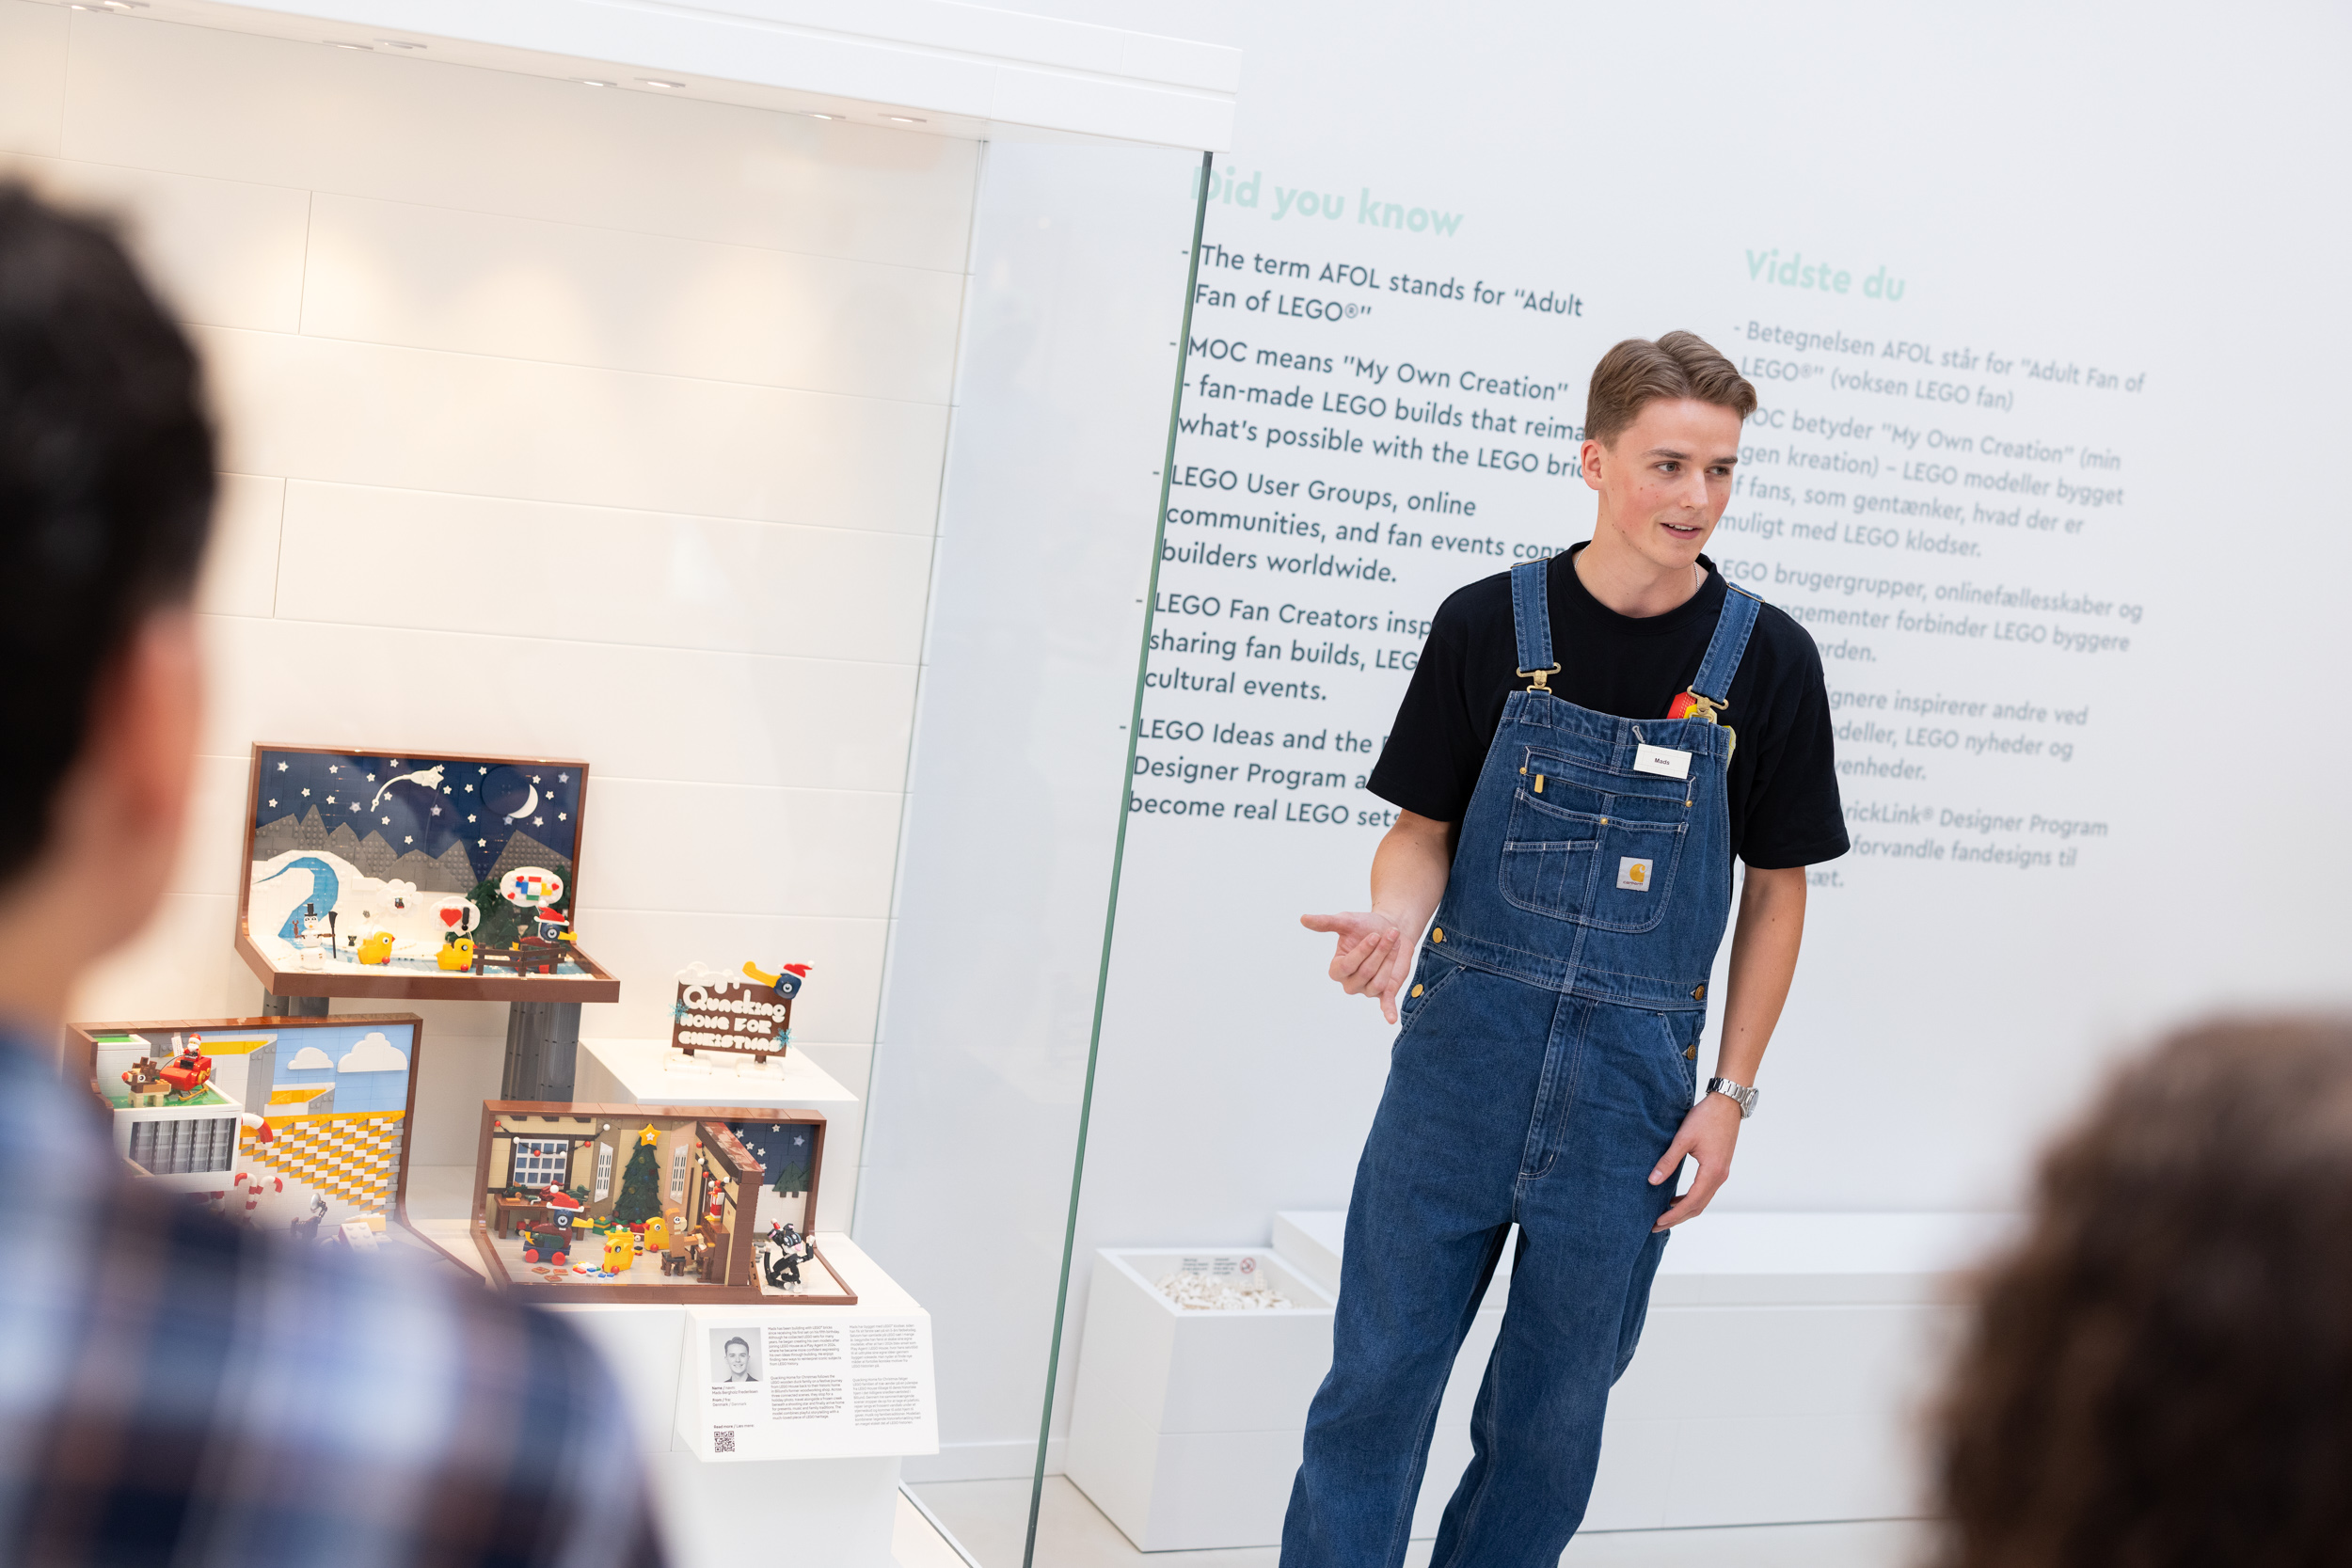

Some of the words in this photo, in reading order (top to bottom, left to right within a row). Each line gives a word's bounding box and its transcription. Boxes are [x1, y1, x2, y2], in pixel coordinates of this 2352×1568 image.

[1190, 166, 1262, 208] Did
[1270, 184, 1344, 221] you
[1358, 187, 1464, 237] know
[1195, 283, 1235, 309] Fan
[1246, 290, 1271, 312] of
[1200, 244, 1245, 270] The
[1254, 253, 1310, 279] term
[1319, 262, 1380, 289] AFOL
[1389, 275, 1464, 300] stands
[1473, 280, 1505, 306] for
[1747, 249, 1850, 293] Vidste
[1865, 267, 1904, 300] du
[1188, 337, 1248, 362] MOC
[1256, 350, 1333, 373] means
[1397, 363, 1450, 388] Own
[1747, 321, 1874, 356] Betegnelsen
[1882, 341, 1933, 365] AFOL
[1941, 348, 1979, 370] står
[1986, 352, 2013, 374] for
[2087, 368, 2119, 388] Fan
[2125, 372, 2145, 392] of
[1200, 374, 1313, 409] fan-made
[1323, 391, 1387, 418] LEGO
[1395, 398, 1462, 427] builds
[1471, 408, 1517, 434] that
[1526, 416, 1585, 440] reima
[1831, 367, 1908, 396] (voksen
[1915, 380, 1970, 404] LEGO
[1977, 386, 2013, 412] fan)
[1178, 413, 1257, 441] what's
[1266, 427, 1363, 453] possible
[1373, 436, 1422, 460] with
[1432, 441, 1469, 465] the
[1478, 448, 1538, 472] LEGO
[1746, 407, 1786, 428] OC
[1792, 409, 1874, 440] betyder
[1927, 429, 1973, 451] Own
[2080, 448, 2121, 469] (min
[1171, 466, 1237, 491] LEGO
[1248, 473, 1300, 497] User
[1308, 480, 1397, 513] Groups,
[1407, 491, 1476, 516] online
[1736, 446, 1780, 467] gen
[1788, 445, 1879, 478] kreation)
[1903, 462, 1958, 485] LEGO
[1964, 471, 2050, 495] modeller
[2057, 478, 2123, 507] bygget
[1749, 476, 1795, 506] fans,
[1804, 489, 1846, 507] som
[1853, 495, 1964, 524] gentænker,
[1973, 502, 2021, 527] hvad
[2026, 510, 2058, 531] der
[2065, 519, 2084, 533] er
[1166, 504, 1326, 544] communities,
[1336, 522, 1379, 544] and
[1388, 523, 1422, 547] fan
[1431, 535, 1504, 556] events
[1791, 521, 1837, 542] med
[1844, 525, 1899, 547] LEGO
[1906, 530, 1980, 557] klodser.
[1162, 540, 1257, 569] builders
[1267, 553, 1396, 582] worldwide.
[1712, 558, 1768, 581] EGO
[1774, 562, 1927, 601] brugergrupper,
[1935, 582, 2113, 615] onlinefællesskaber
[2119, 604, 2143, 624] og
[1154, 593, 1220, 617] LEGO
[1230, 599, 1269, 622] Fan
[1279, 604, 1378, 631] Creators
[1386, 610, 1432, 640] insp
[1897, 610, 1987, 637] forbinder
[1994, 622, 2046, 643] LEGO
[2053, 626, 2130, 653] byggere
[1149, 628, 1236, 661] sharing
[1246, 636, 1281, 659] fan
[1291, 640, 1365, 672] builds,
[1375, 650, 1420, 671] LEG
[1145, 667, 1235, 693] cultural
[1244, 680, 1327, 701] events.
[1894, 689, 1987, 717] inspirerer
[1993, 702, 2047, 722] andre
[2055, 706, 2089, 725] ved
[1138, 720, 1204, 741] LEGO
[1213, 722, 1274, 747] Ideas
[1282, 729, 1327, 750] and
[1335, 730, 1372, 753] the
[1905, 728, 1959, 749] LEGO
[1965, 732, 2043, 755] nyheder
[2049, 742, 2074, 762] og
[1133, 754, 1239, 784] Designer
[1247, 763, 1346, 790] Program
[1128, 791, 1225, 817] become
[1233, 799, 1278, 820] real
[1286, 802, 1349, 824] LEGO
[1843, 800, 1933, 826] rickLink®
[1940, 808, 2023, 834] Designer
[2029, 815, 2108, 839] Program
[1852, 833, 1945, 860] forvandle
[1952, 840, 2051, 869] fandesigns
[2058, 847, 2077, 866] til
